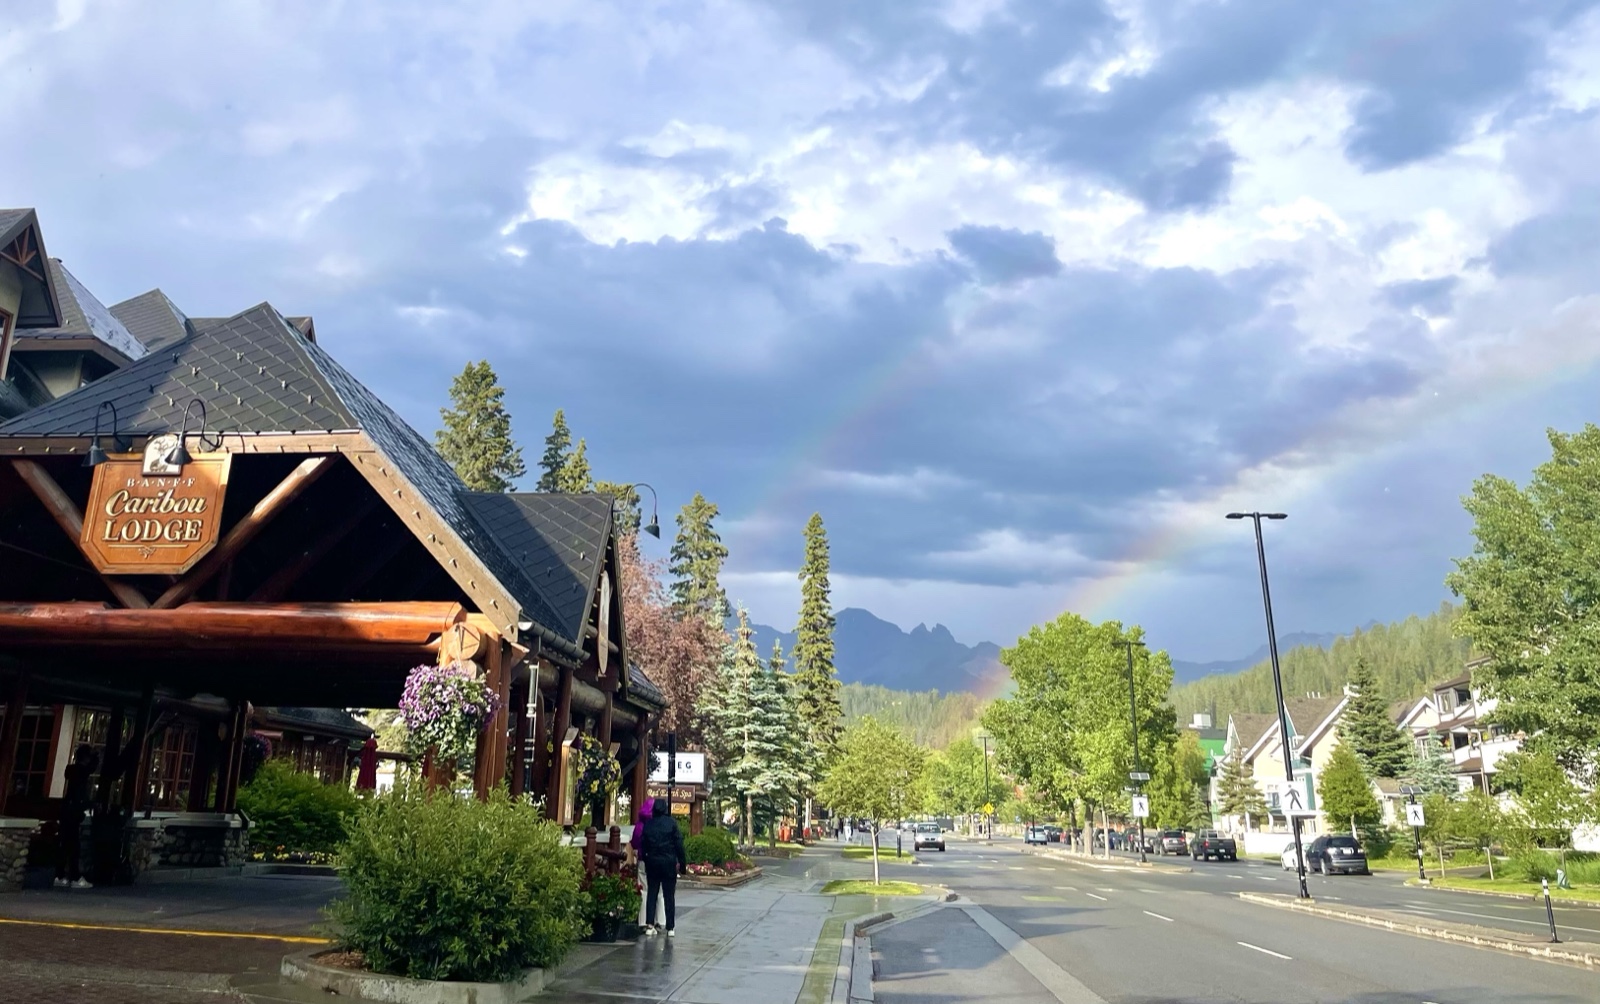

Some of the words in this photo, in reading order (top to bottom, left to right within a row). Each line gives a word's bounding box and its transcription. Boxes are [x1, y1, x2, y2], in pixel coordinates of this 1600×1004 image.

[105, 488, 207, 517] Caribou
[102, 519, 203, 541] LODGE
[680, 789, 692, 800] Spa
